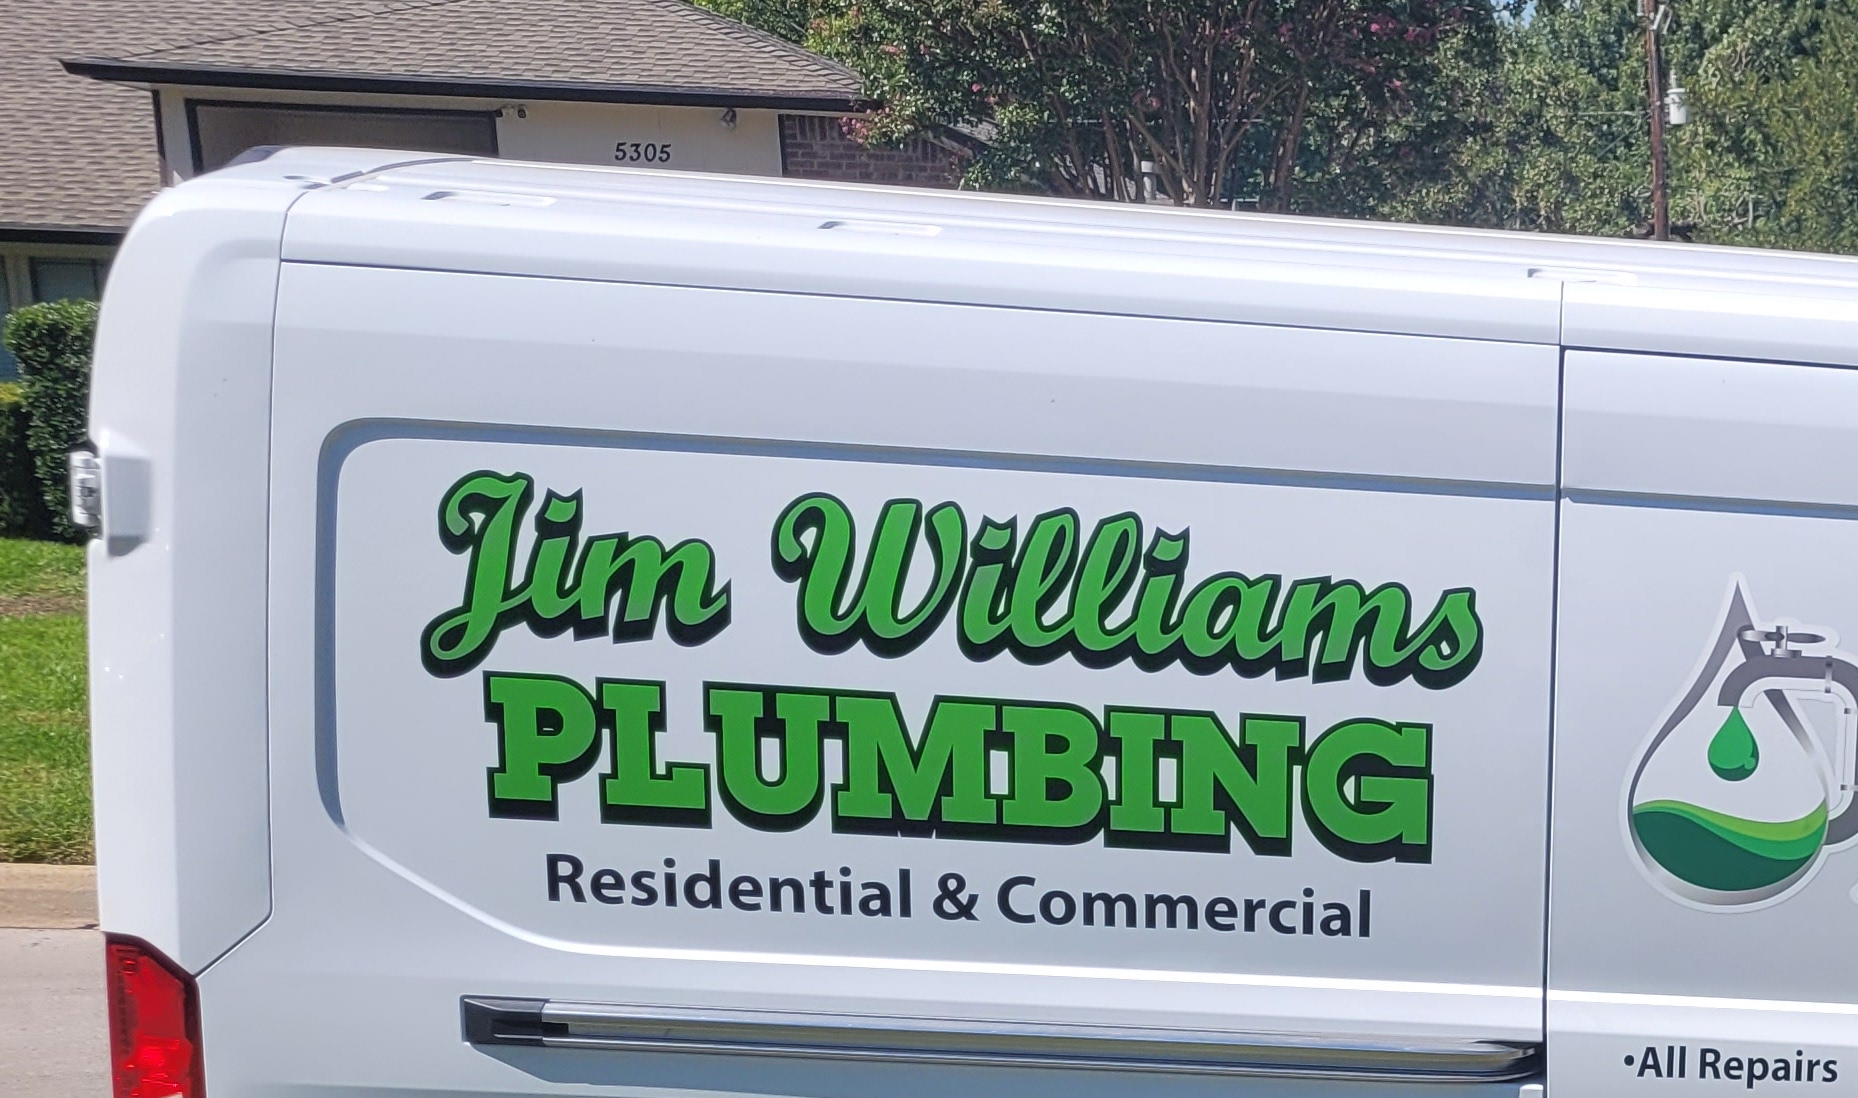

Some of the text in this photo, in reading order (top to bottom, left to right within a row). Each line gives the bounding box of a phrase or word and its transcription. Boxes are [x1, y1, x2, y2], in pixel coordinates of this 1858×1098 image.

[614, 141, 672, 163] 5305
[421, 470, 1484, 688] Jim Williams
[483, 671, 1434, 863] PLUMBING
[544, 852, 1372, 938] Residential & Commercial
[1699, 1048, 1839, 1089] Repairs
